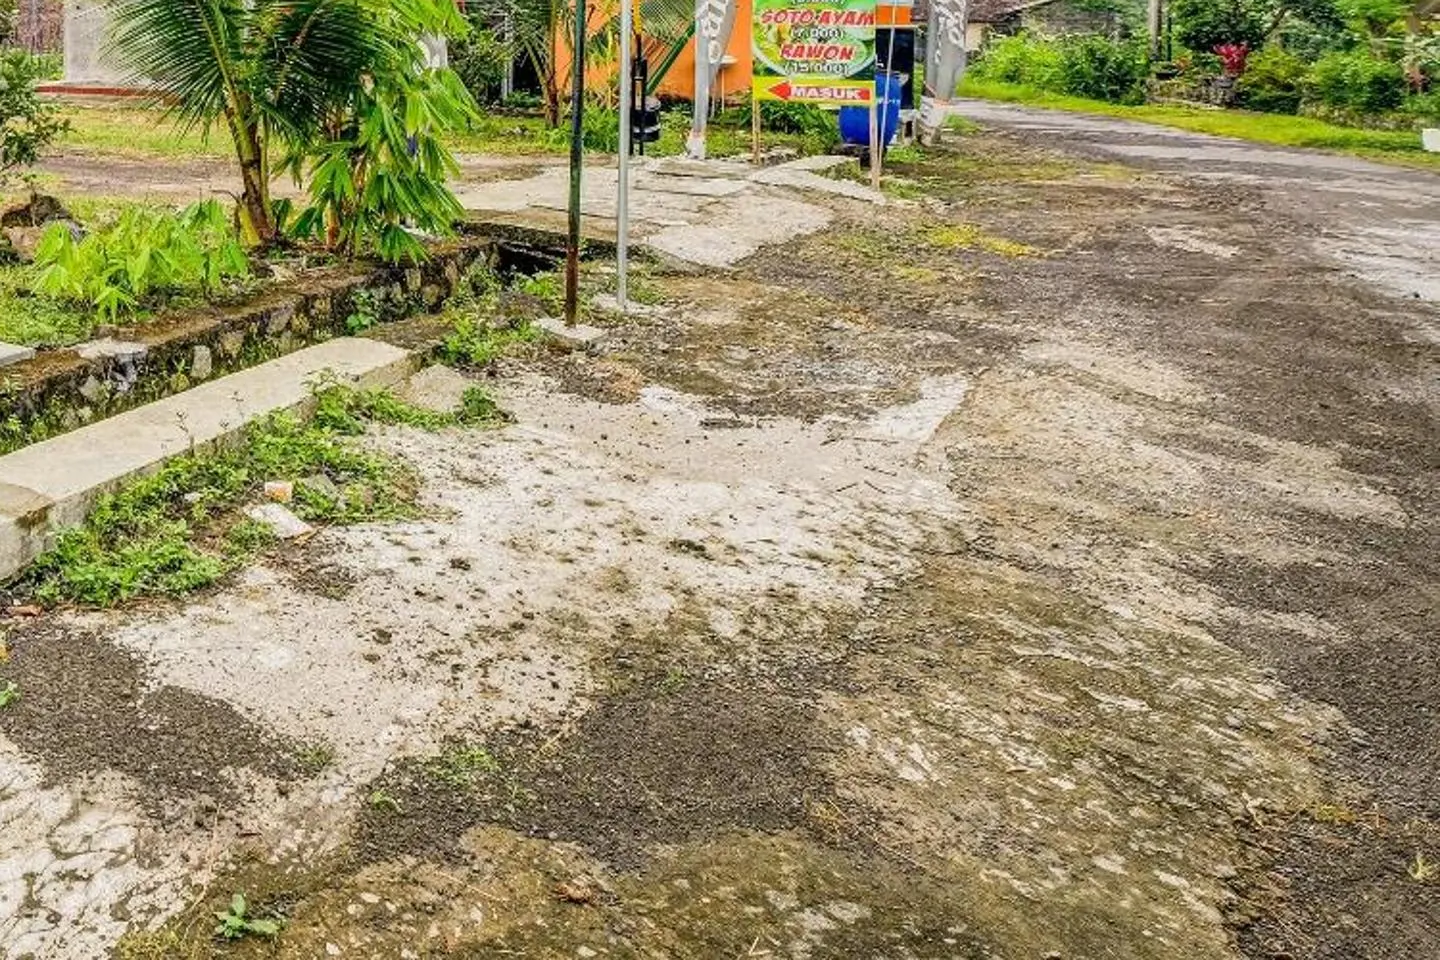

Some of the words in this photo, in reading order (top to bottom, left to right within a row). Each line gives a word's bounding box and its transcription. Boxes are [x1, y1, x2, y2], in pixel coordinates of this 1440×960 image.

[761, 10, 814, 25] SOTO
[817, 10, 875, 25] AYAM
[780, 42, 854, 60] RAWON
[790, 87, 860, 99] MASUK
